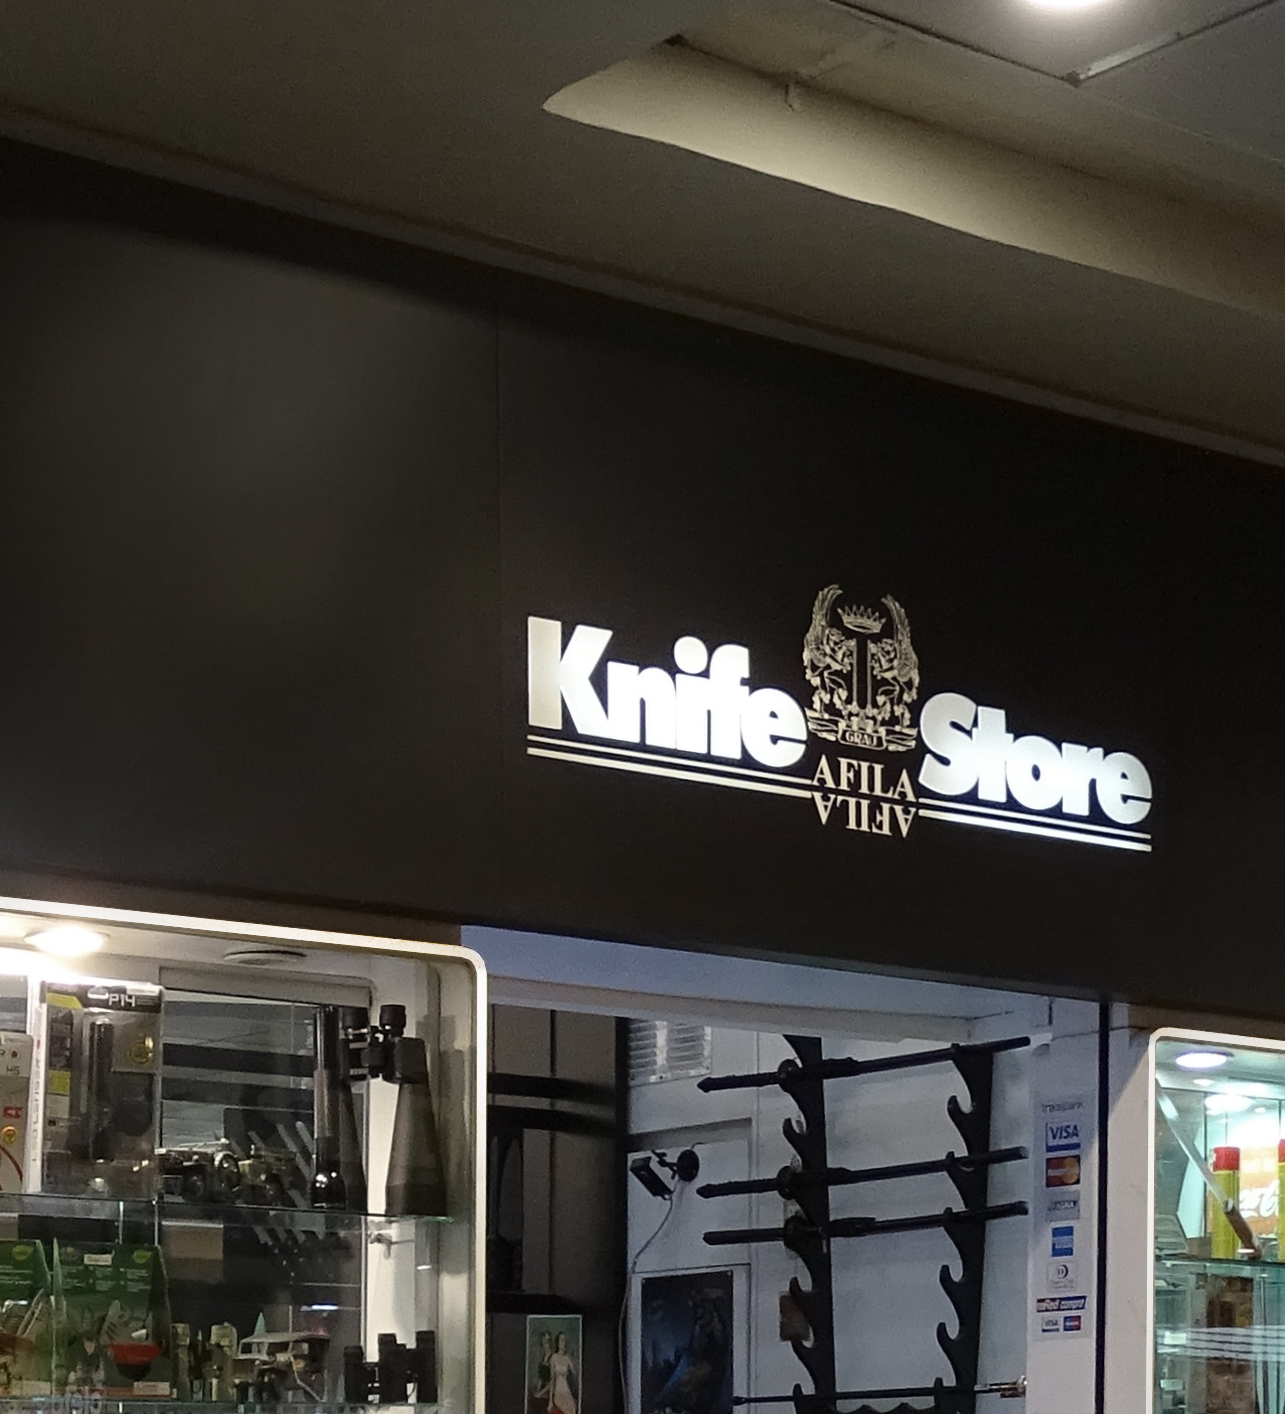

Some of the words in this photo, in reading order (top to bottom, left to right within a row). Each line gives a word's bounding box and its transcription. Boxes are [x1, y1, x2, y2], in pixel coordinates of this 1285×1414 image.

[526, 615, 808, 768] Knife
[918, 691, 1152, 825] Store
[811, 754, 917, 803] AFILA
[108, 993, 136, 1008] P14
[1049, 1124, 1080, 1140] VISA
